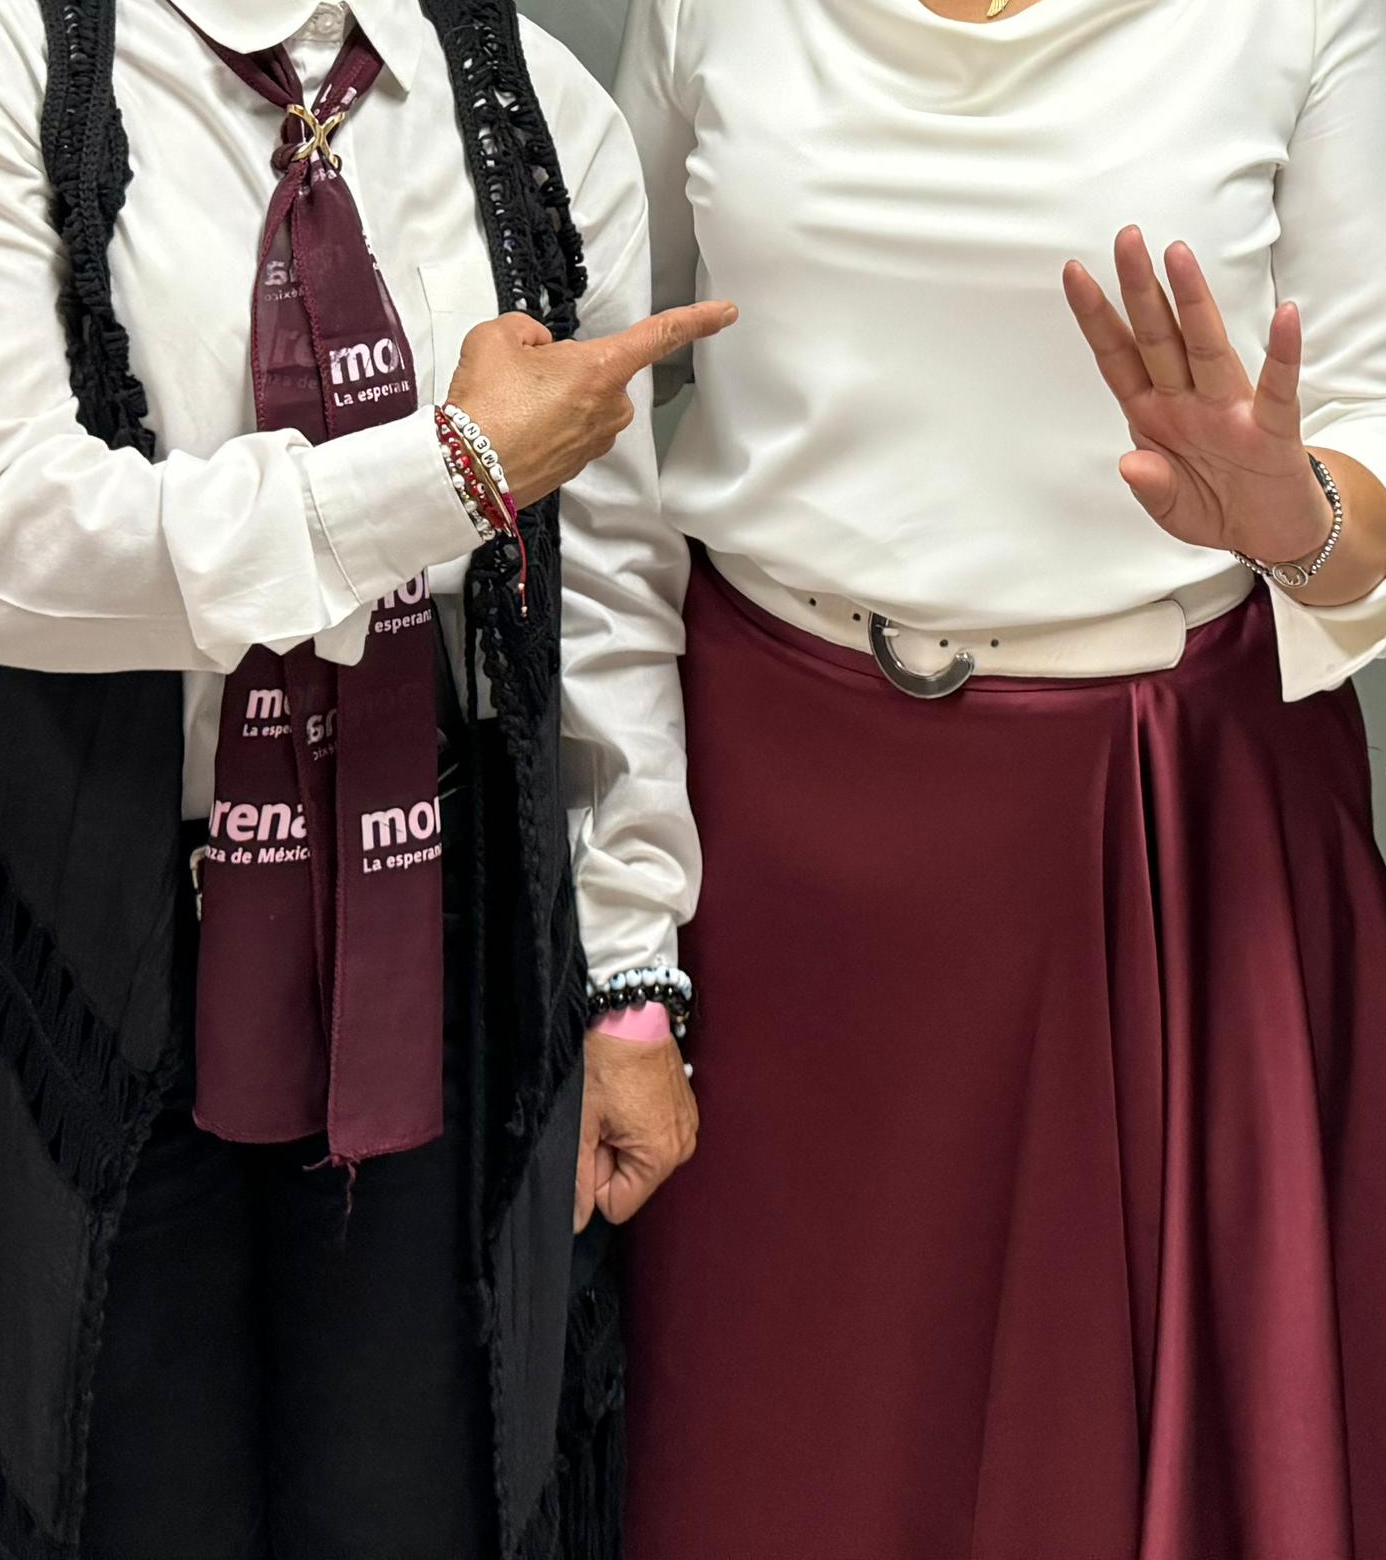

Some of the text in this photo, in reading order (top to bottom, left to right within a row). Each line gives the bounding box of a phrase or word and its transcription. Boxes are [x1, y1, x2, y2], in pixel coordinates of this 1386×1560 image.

[329, 338, 405, 385] mo
[334, 392, 354, 407] La
[246, 689, 291, 719] m
[243, 724, 258, 737] La
[209, 800, 307, 842] rena
[231, 847, 252, 864] de
[258, 845, 311, 864] Méxic
[363, 858, 382, 873] La
